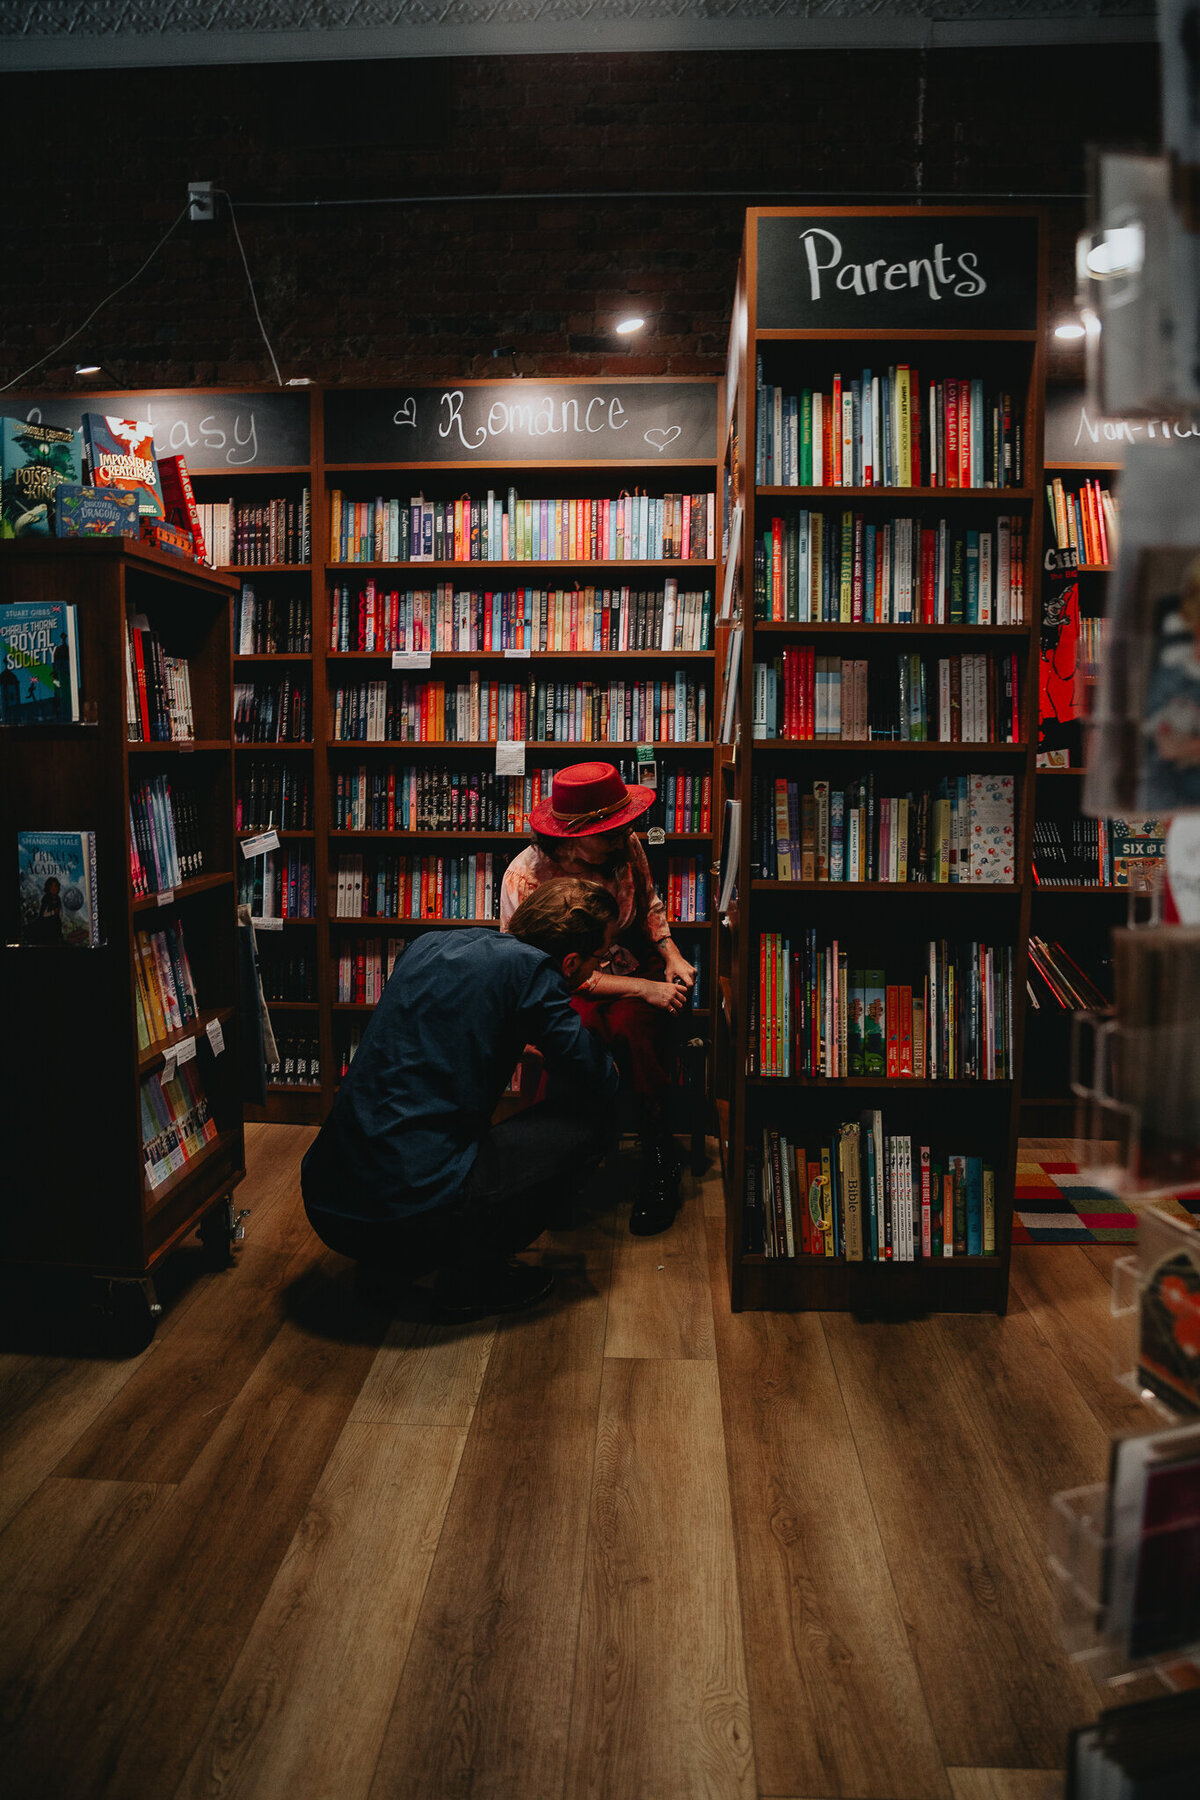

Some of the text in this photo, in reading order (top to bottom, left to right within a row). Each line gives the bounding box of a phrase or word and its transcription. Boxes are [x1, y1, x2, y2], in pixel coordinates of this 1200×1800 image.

[799, 228, 988, 301] Parents
[438, 390, 629, 450] Romance
[803, 406, 811, 416] Back
[949, 383, 957, 452] LOVE LEARN
[803, 429, 811, 444] Family
[961, 385, 969, 469] Reading for Our Lives
[99, 453, 152, 473] IMPOSSIBLE
[100, 466, 156, 486] CREATURES
[178, 458, 200, 526] WHACK JOB
[81, 507, 121, 521] DRAGONS
[953, 540, 963, 574] Reading
[30, 609, 50, 617] GIBBS
[1, 618, 58, 637] CHARLIE THORNE
[10, 630, 55, 653] ROYAL
[6, 647, 57, 671] SOCIETY
[546, 682, 554, 732] COLLEEN HOOVER
[22, 838, 80, 846] SHANNON HALE
[900, 838, 908, 862] PRAYERS
[941, 838, 949, 862] PRAYERS
[1122, 843, 1144, 855] SIX
[29, 861, 73, 875] ACADEMY
[913, 1039, 923, 1069] BIBLE
[848, 1180, 858, 1212] Bible
[921, 1186, 930, 1202] GIRLS
